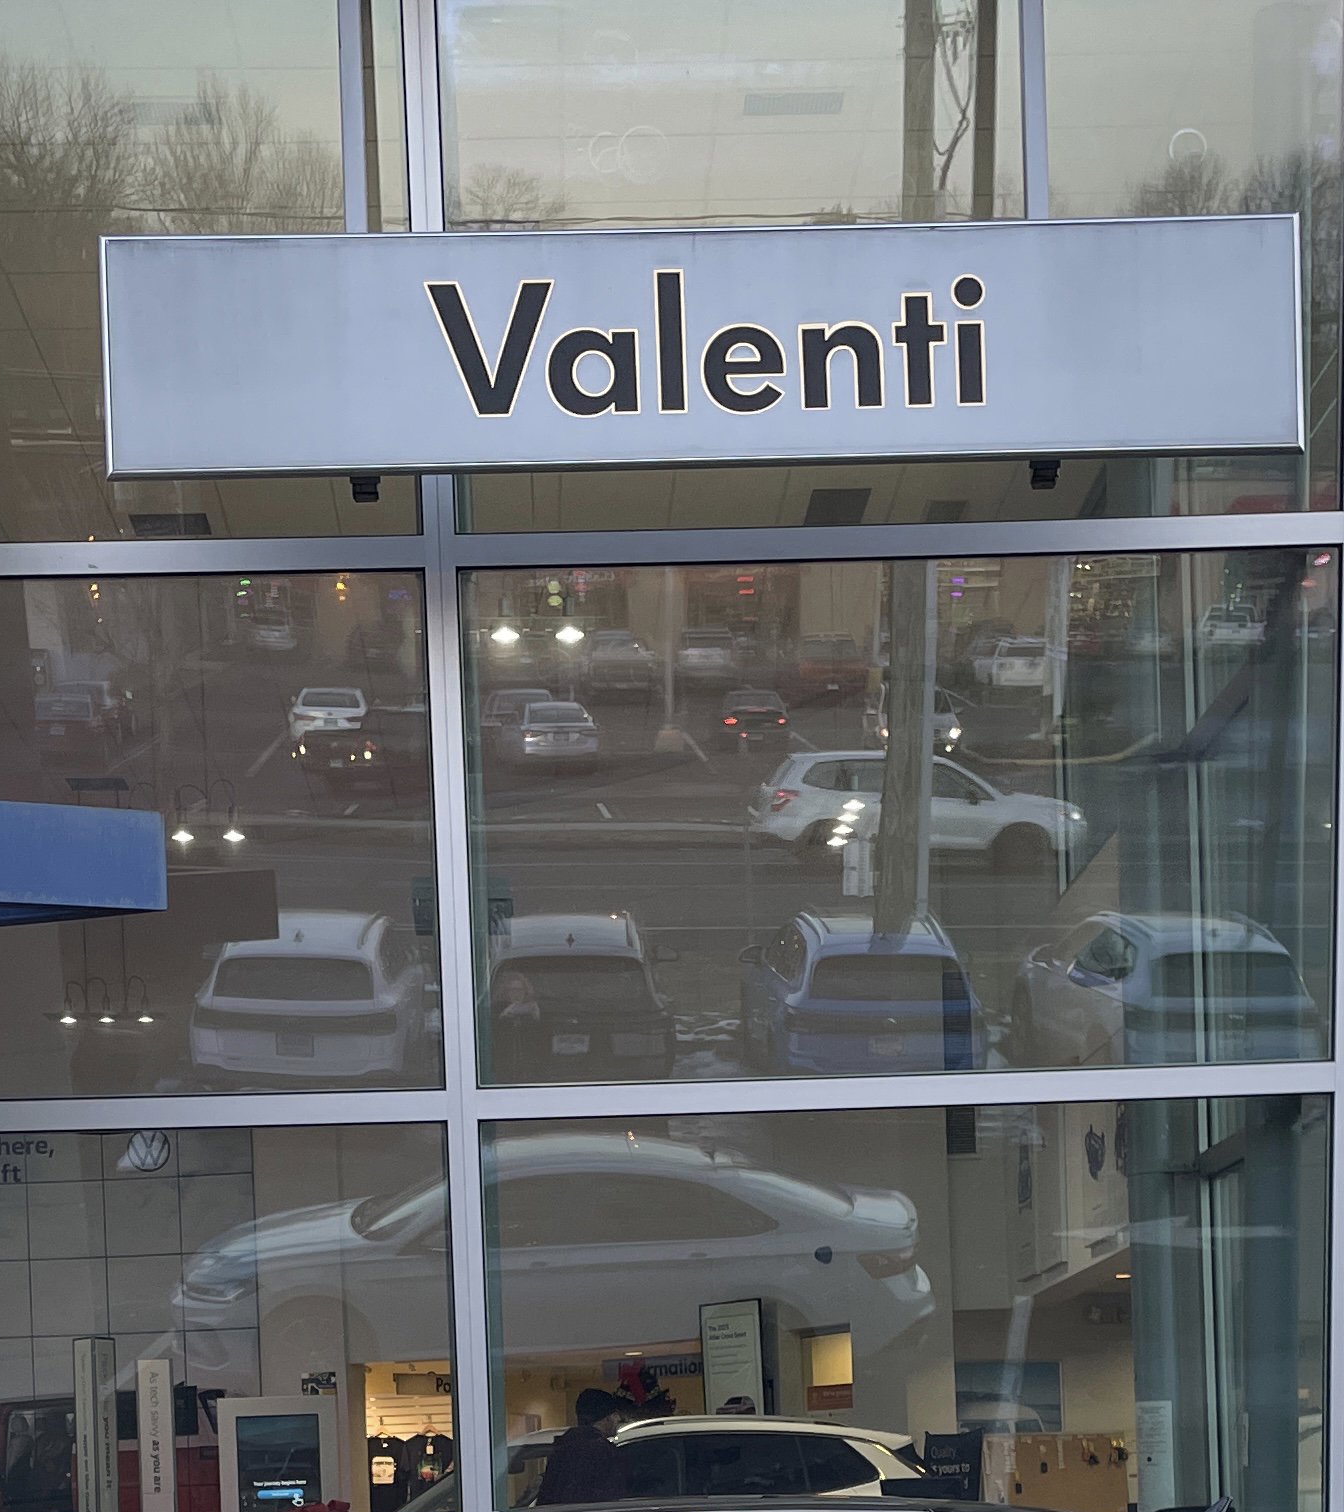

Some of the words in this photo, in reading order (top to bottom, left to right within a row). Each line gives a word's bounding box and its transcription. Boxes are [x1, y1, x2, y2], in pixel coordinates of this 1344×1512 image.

[424, 267, 987, 418] Valenti
[152, 1440, 160, 1453] as
[151, 1454, 161, 1474] you
